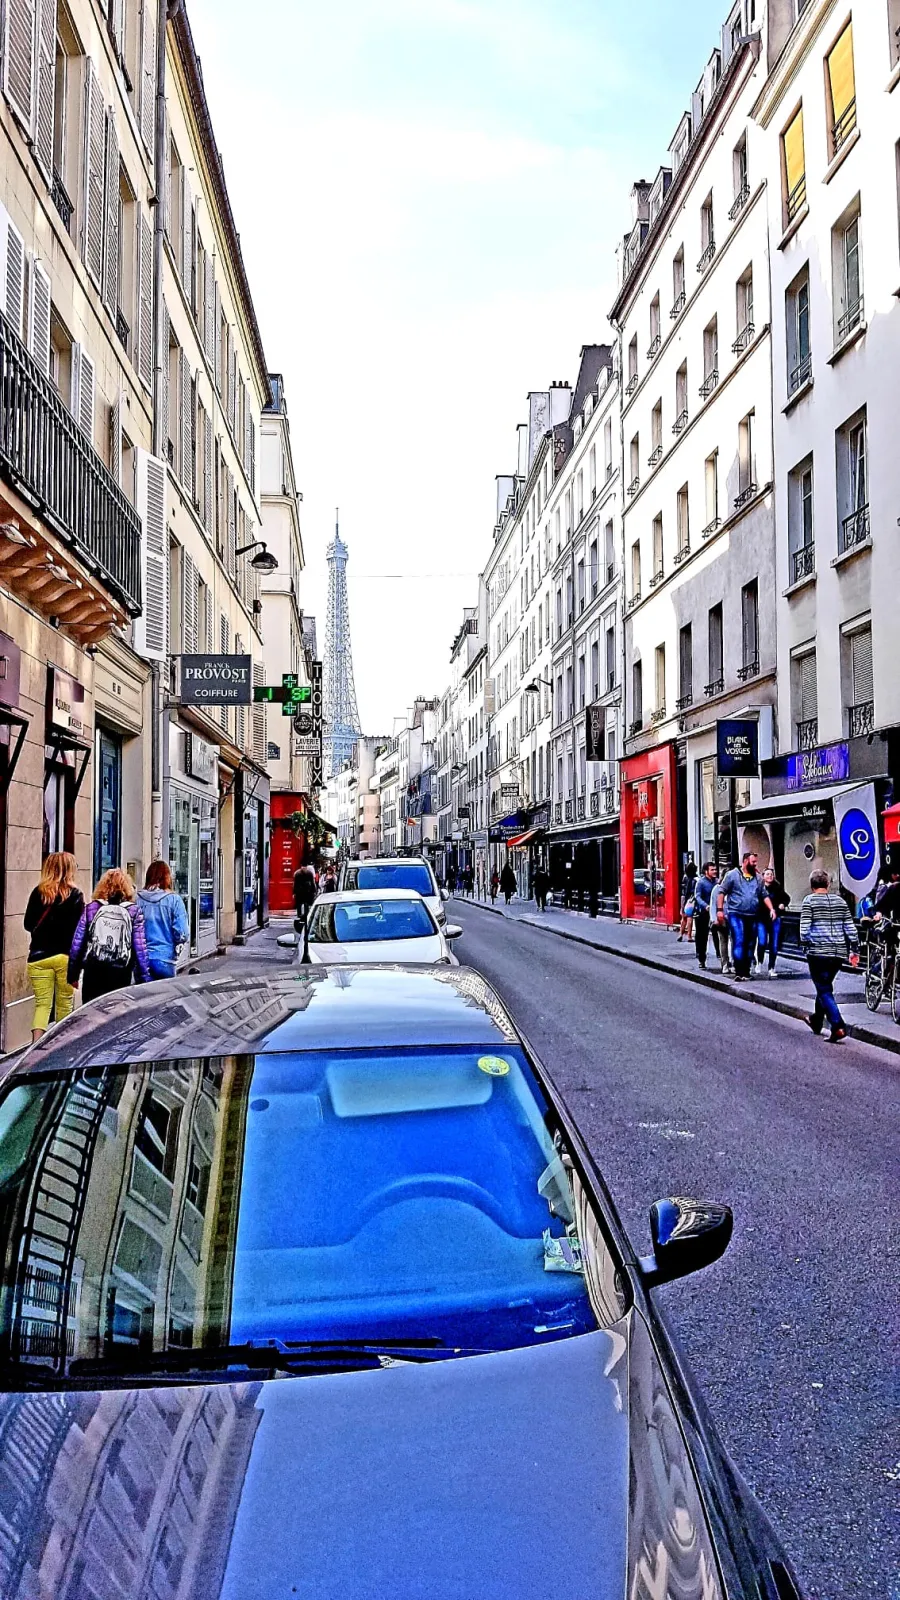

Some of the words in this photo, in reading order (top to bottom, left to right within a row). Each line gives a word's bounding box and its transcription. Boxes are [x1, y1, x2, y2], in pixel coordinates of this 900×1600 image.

[185, 668, 248, 680] PROVOST
[194, 689, 239, 697] COIFFURE
[313, 664, 322, 783] THOUMIUX
[726, 736, 749, 745] BLANC
[724, 747, 751, 755] VOSGES
